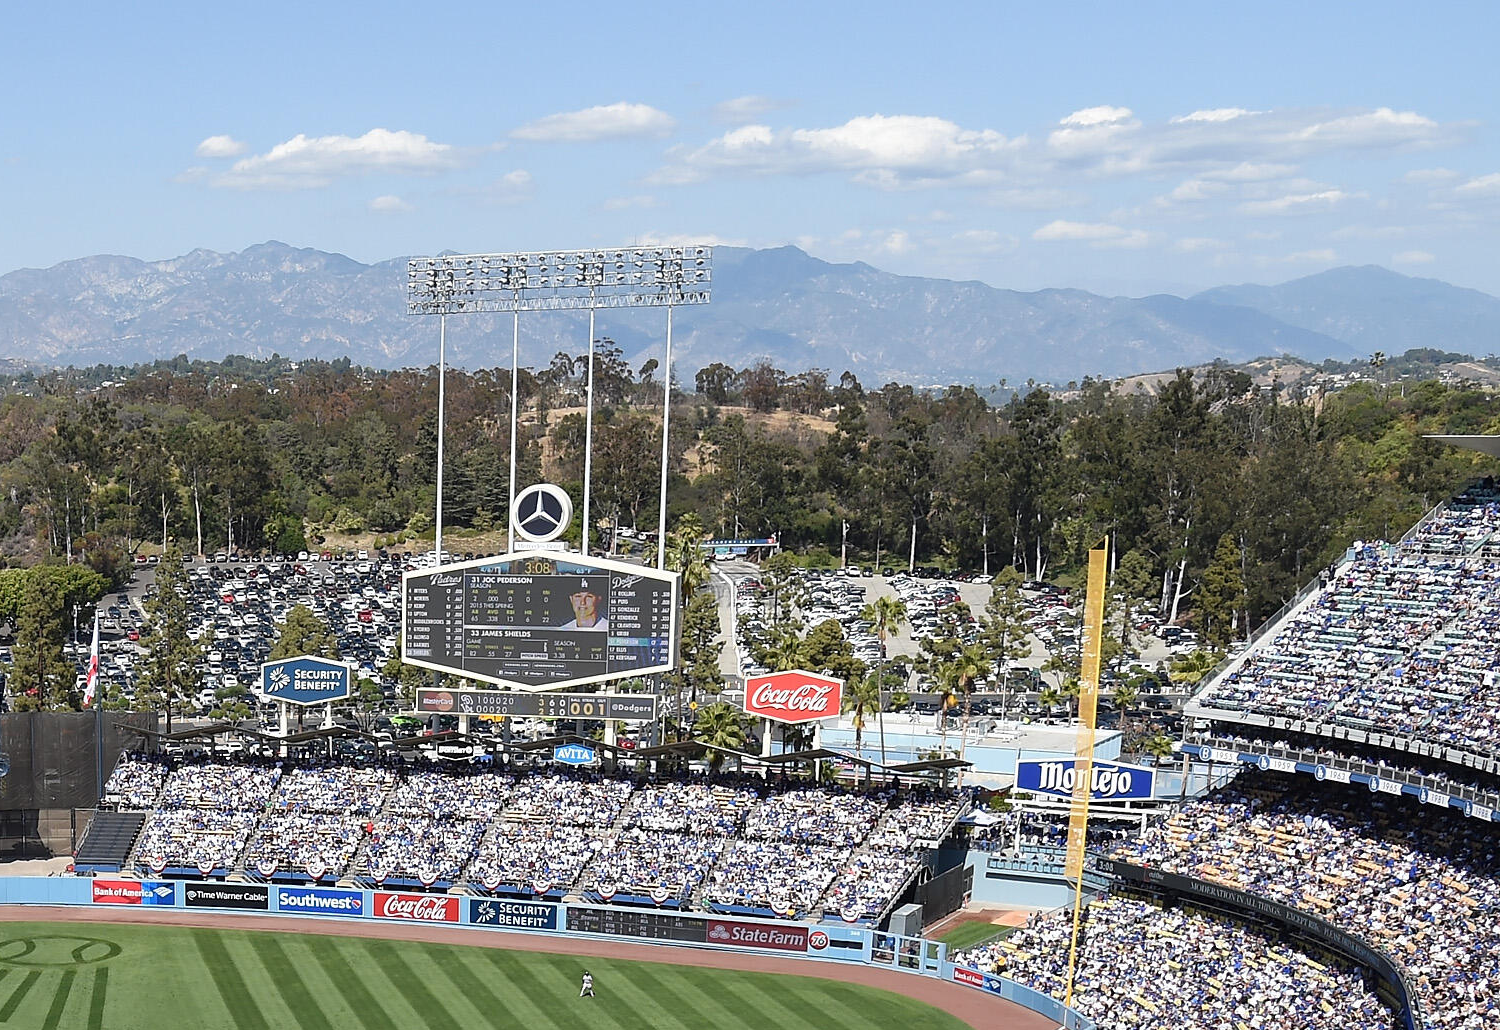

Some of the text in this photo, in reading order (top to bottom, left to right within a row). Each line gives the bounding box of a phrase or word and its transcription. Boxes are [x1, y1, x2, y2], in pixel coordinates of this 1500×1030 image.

[524, 563, 550, 574] 3:08
[294, 669, 343, 680] SECURITY
[538, 698, 565, 707] 3 6 0
[751, 683, 833, 711] Coca-Cola
[538, 707, 566, 716] 2 5 0
[571, 703, 605, 715] 0 0 1
[611, 703, 652, 713] @Dodgers
[557, 748, 590, 760] AVITA
[1216, 751, 1233, 760] 1955
[1273, 761, 1291, 770] 1959
[1039, 763, 1132, 796] Montejo
[1329, 771, 1346, 780] 1963
[1099, 861, 1114, 872] 3:08
[94, 887, 153, 898] Bank of America
[197, 891, 267, 902] Time Warner Cable
[280, 893, 351, 910] Southwest
[383, 894, 448, 920] Coca-Cola
[500, 902, 551, 917] SECURITY
[811, 934, 826, 947] 76
